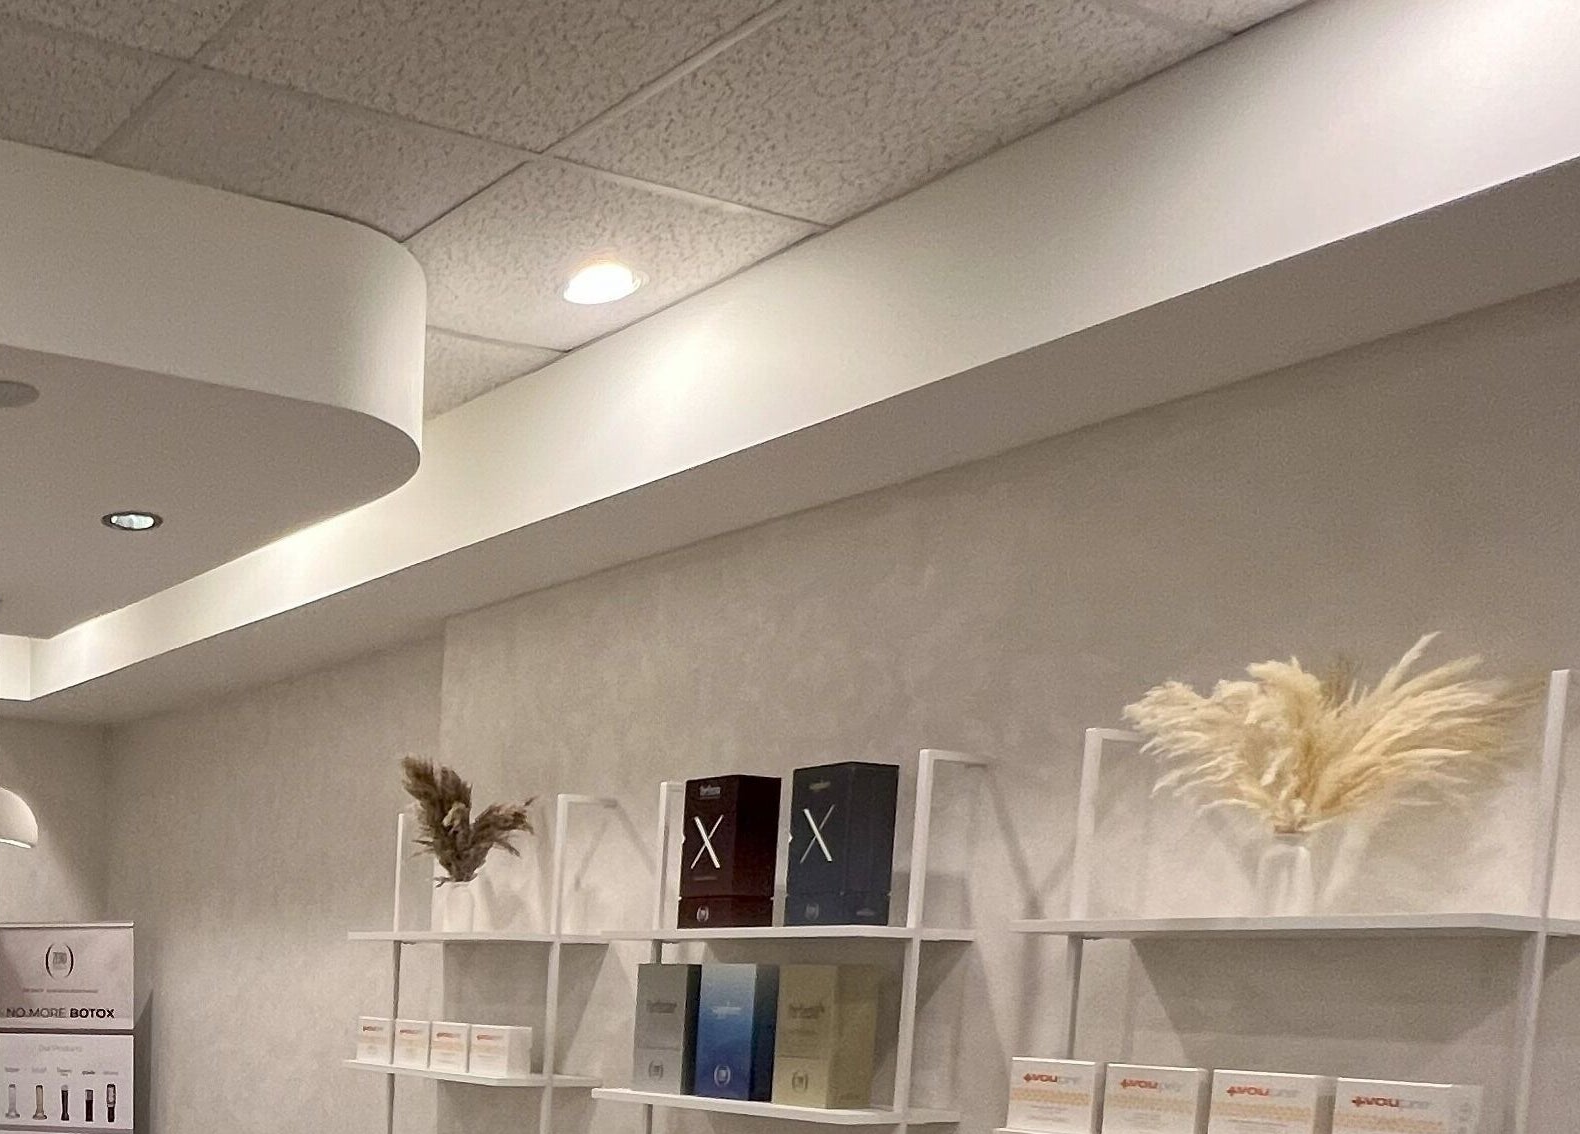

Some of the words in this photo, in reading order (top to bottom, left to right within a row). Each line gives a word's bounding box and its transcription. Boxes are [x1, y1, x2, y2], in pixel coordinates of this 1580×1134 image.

[690, 814, 724, 869] X
[6, 1007, 26, 1018] NO
[28, 1007, 67, 1018] MORE
[69, 1008, 115, 1019] BOTOX
